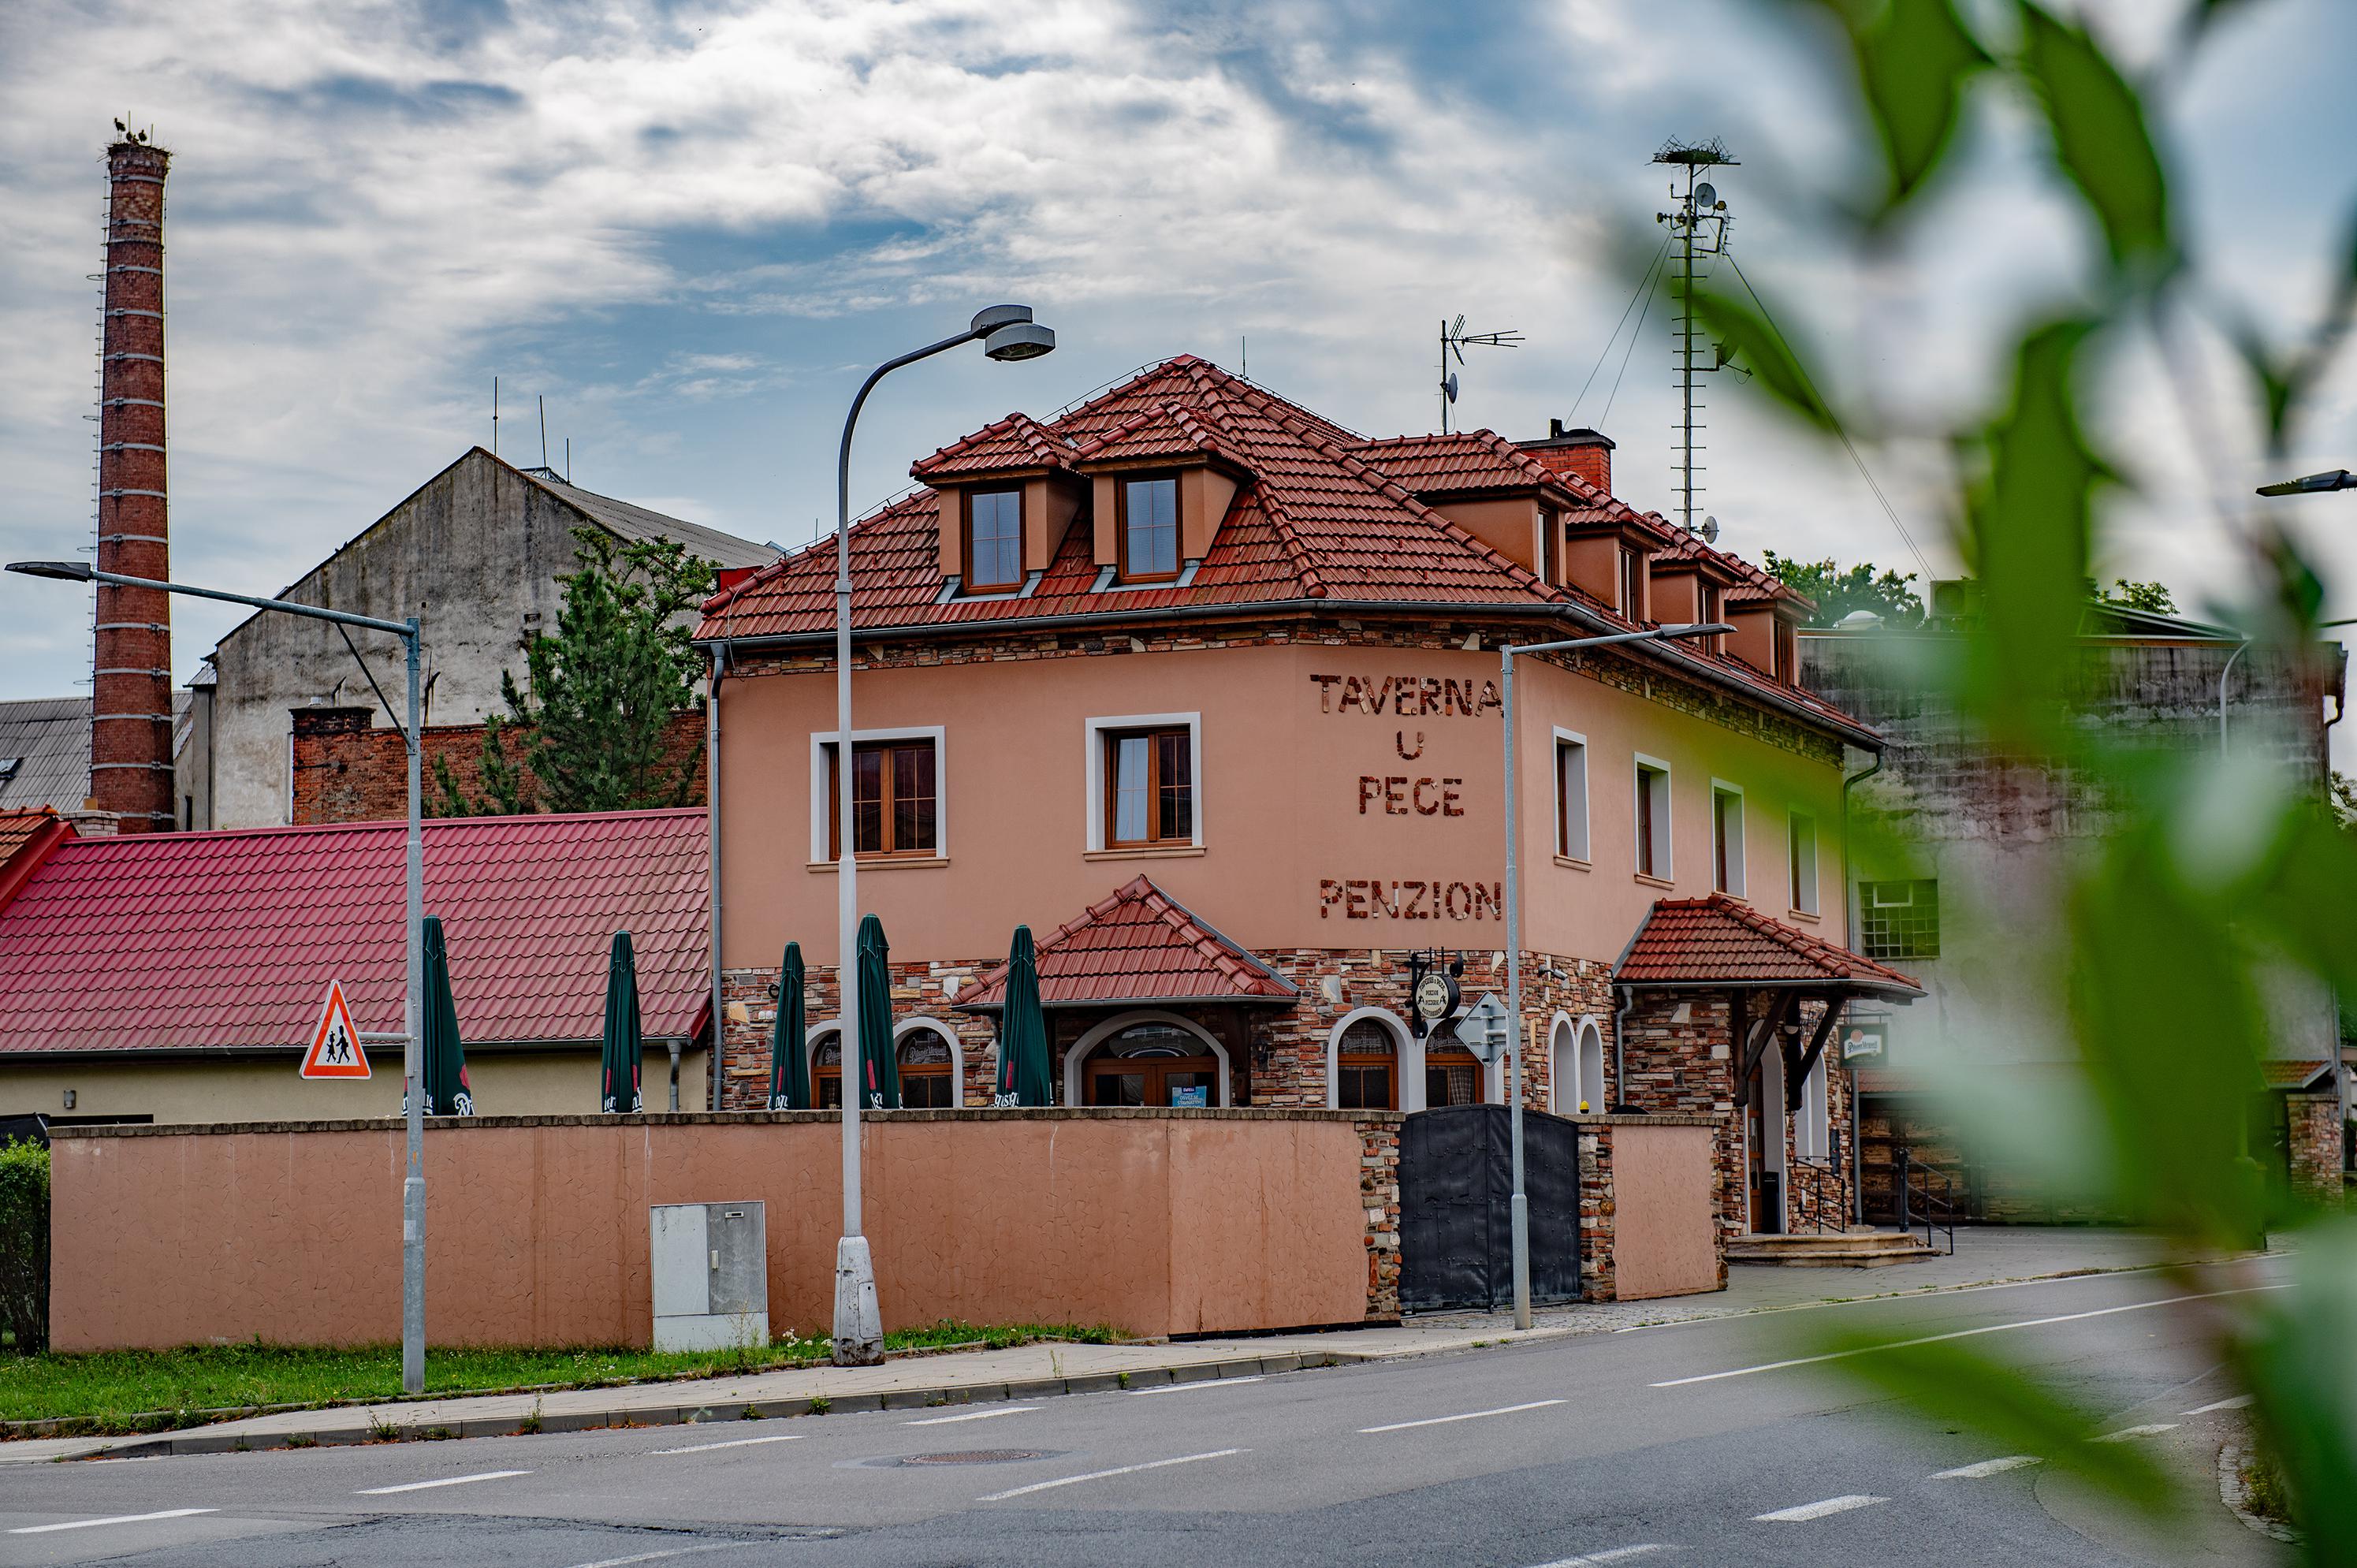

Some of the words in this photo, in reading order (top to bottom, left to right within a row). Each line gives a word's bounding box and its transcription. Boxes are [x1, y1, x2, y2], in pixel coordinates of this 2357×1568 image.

[1309, 674, 1505, 718] TAVERNA
[1396, 730, 1425, 761] U
[1358, 776, 1465, 817] PECE
[1320, 879, 1502, 921] PENZION
